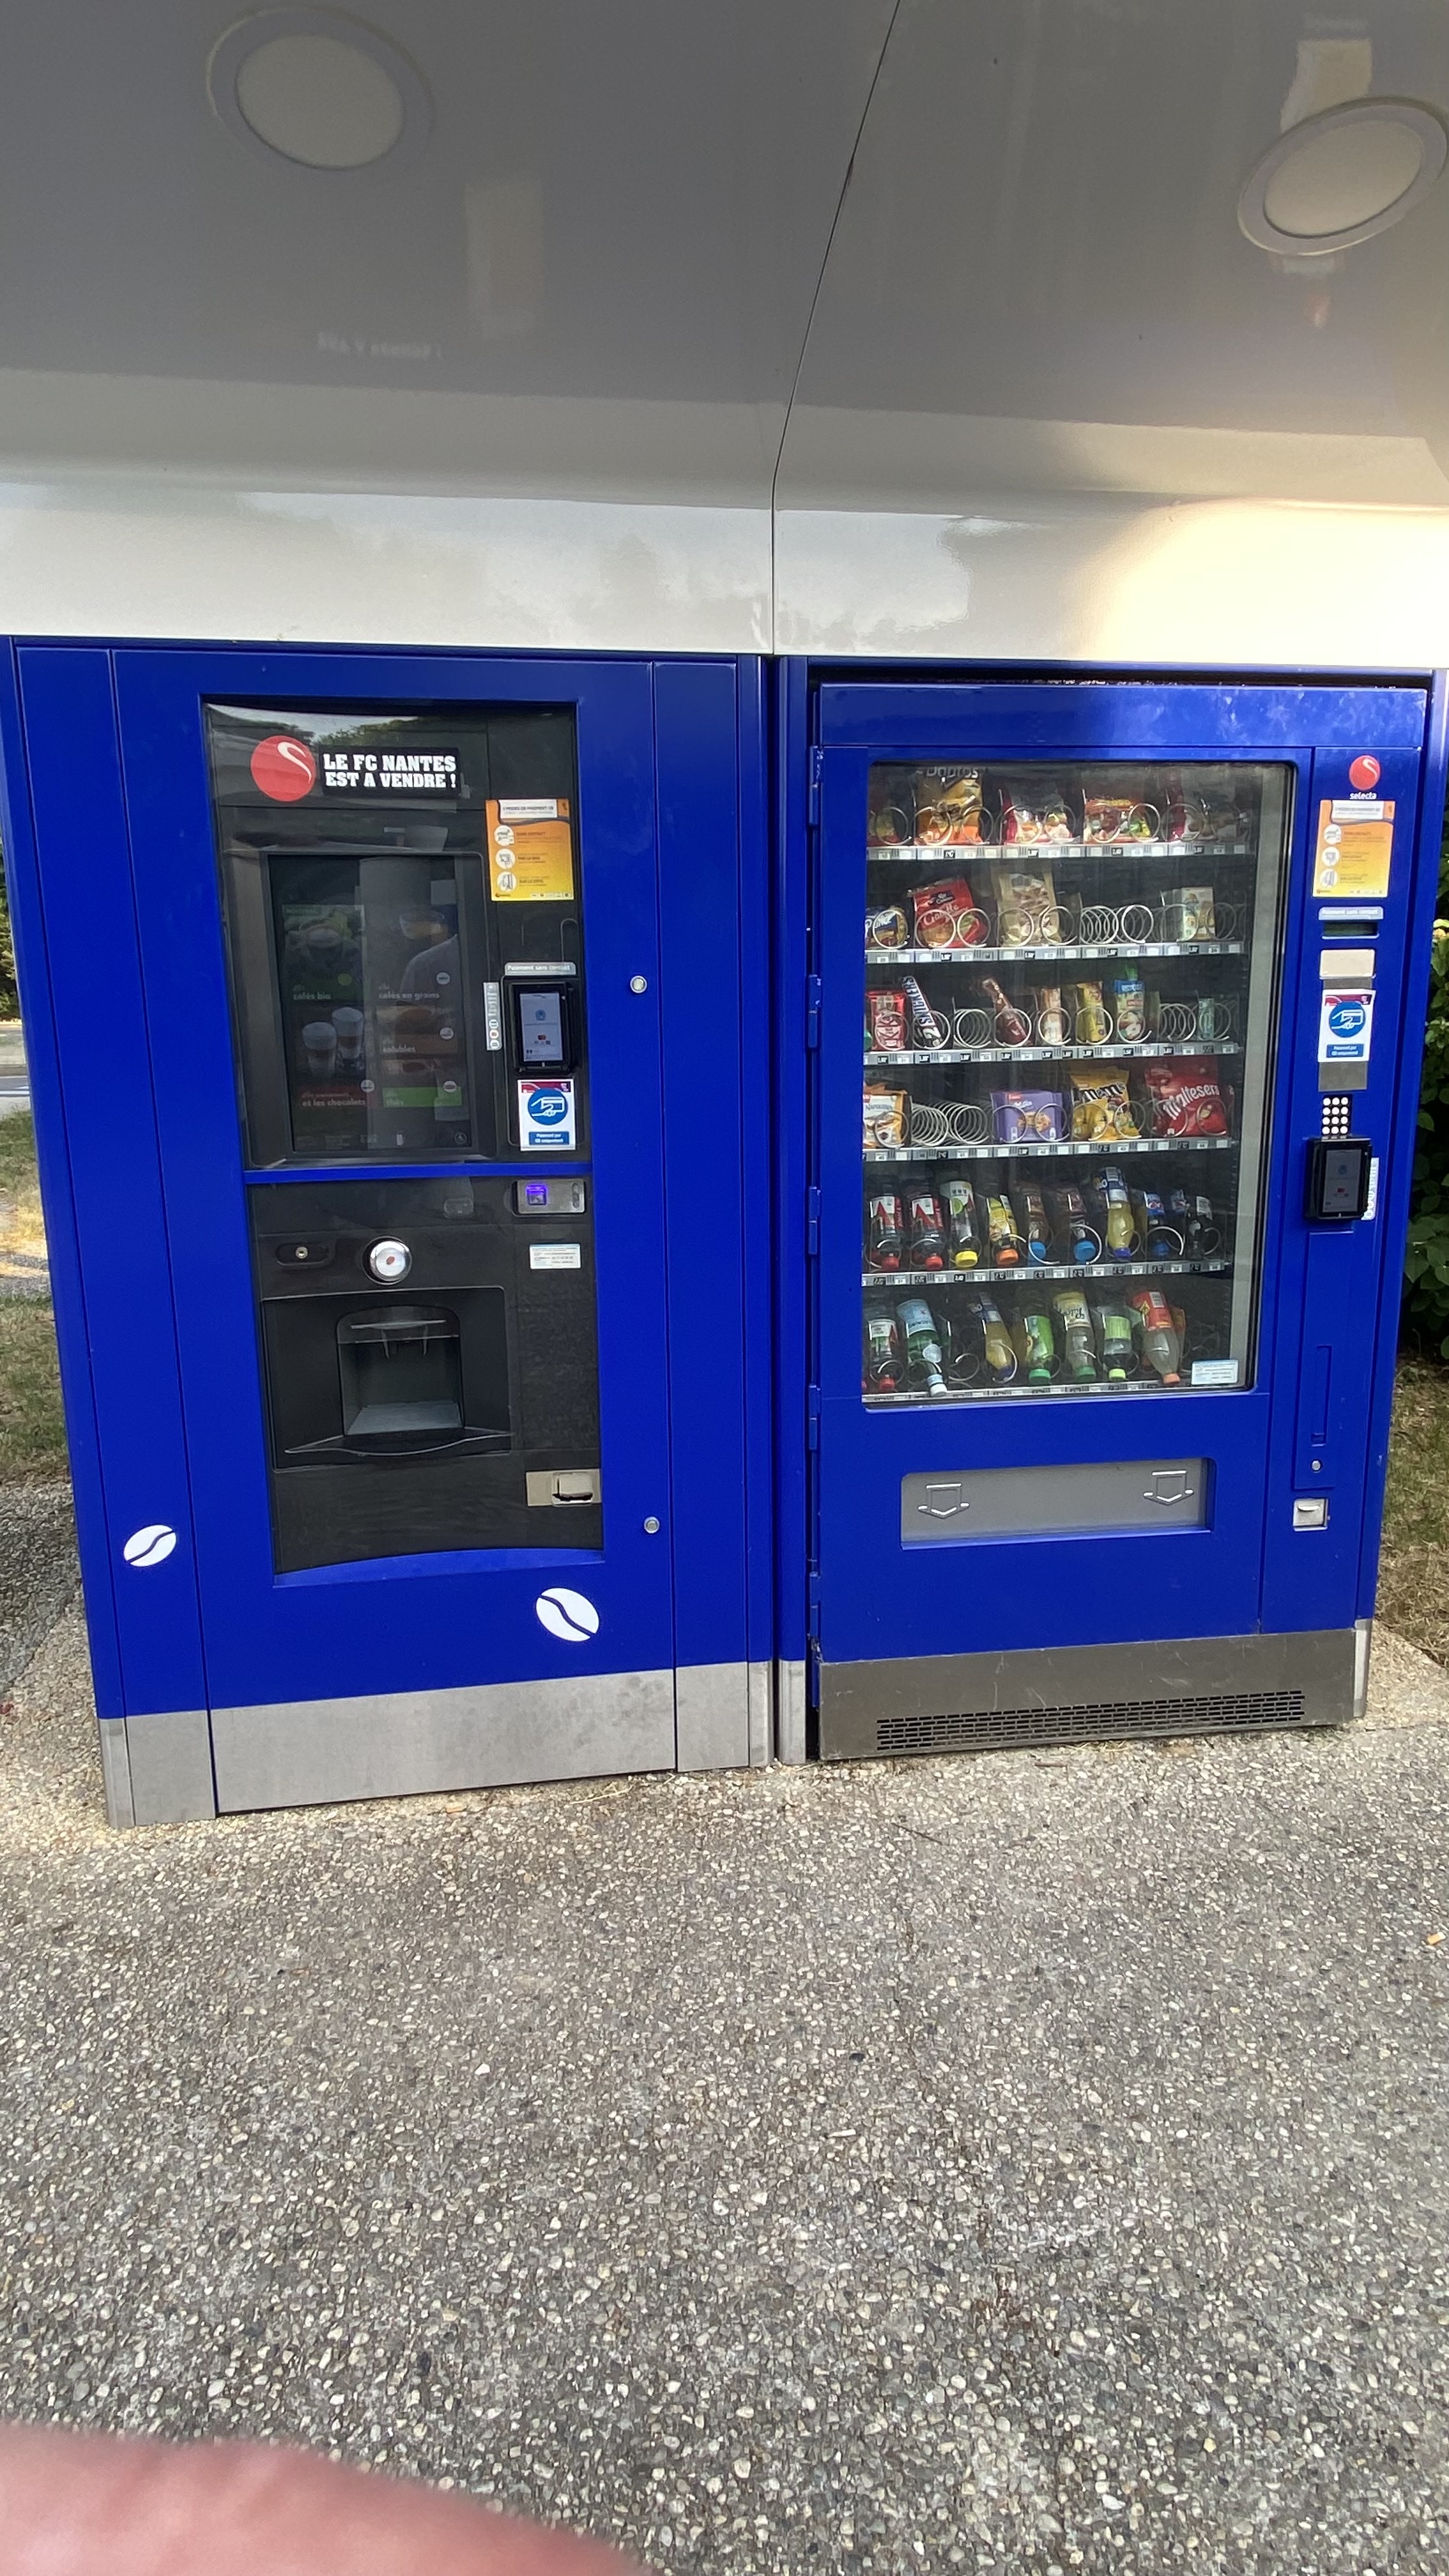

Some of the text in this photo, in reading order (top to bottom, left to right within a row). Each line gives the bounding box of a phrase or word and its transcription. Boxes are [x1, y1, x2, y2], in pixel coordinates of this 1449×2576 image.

[323, 754, 456, 772] LE FC NANTES
[325, 772, 456, 788] EST A VENDRE !
[1349, 792, 1377, 800] selecta
[414, 992, 440, 1000] grains
[383, 1045, 416, 1053] solubles
[1162, 1084, 1220, 1120] Maltesers
